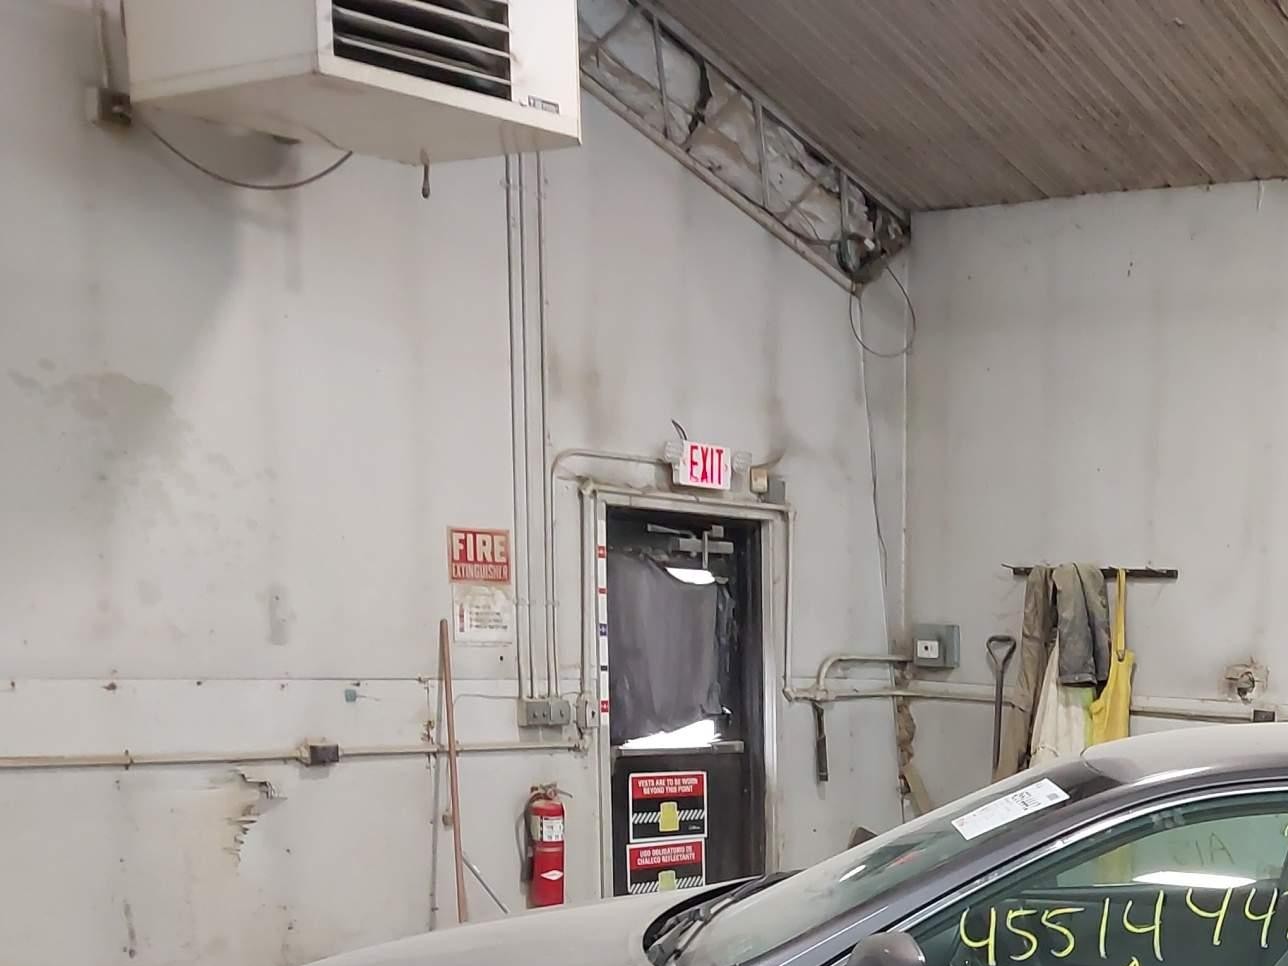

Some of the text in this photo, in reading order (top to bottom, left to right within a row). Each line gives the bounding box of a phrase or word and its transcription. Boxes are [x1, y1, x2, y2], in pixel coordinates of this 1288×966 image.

[689, 444, 724, 485] EXIT
[452, 532, 507, 563] FIRE
[452, 562, 508, 580] EXTINGUISHER
[656, 778, 665, 786] ARE
[643, 786, 665, 794] BEYOND
[686, 845, 692, 853] DE
[637, 857, 660, 866] CHALECO
